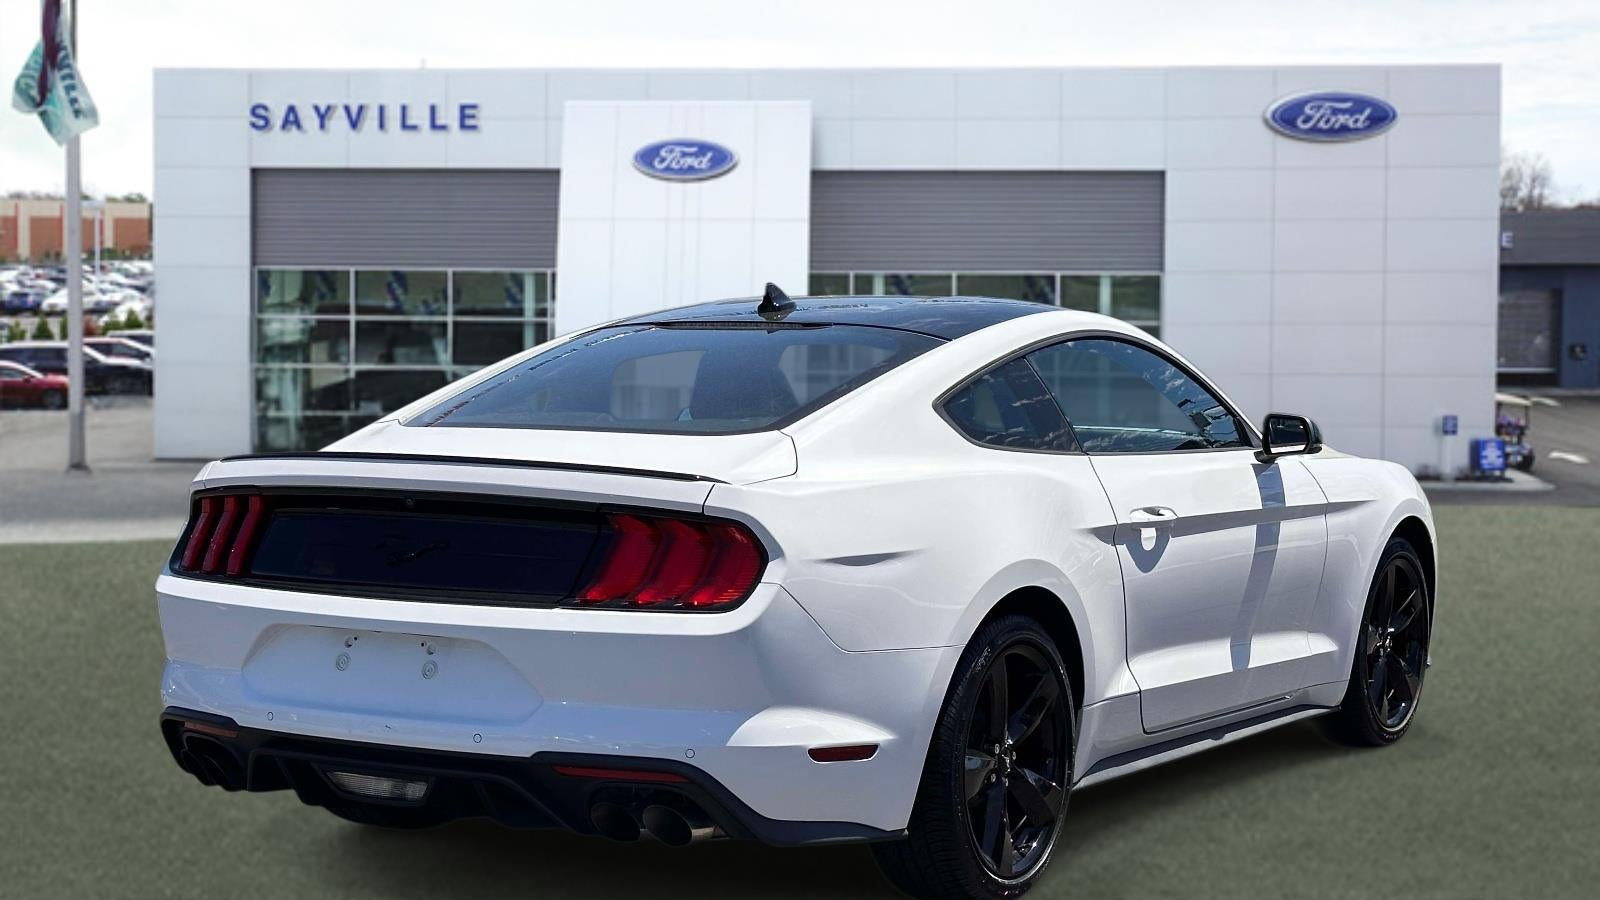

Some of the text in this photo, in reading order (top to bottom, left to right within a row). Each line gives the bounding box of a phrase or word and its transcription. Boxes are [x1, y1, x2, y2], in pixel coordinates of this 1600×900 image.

[249, 103, 479, 132] SAYVILLE
[1296, 101, 1372, 130] Ford
[653, 144, 714, 169] Ford
